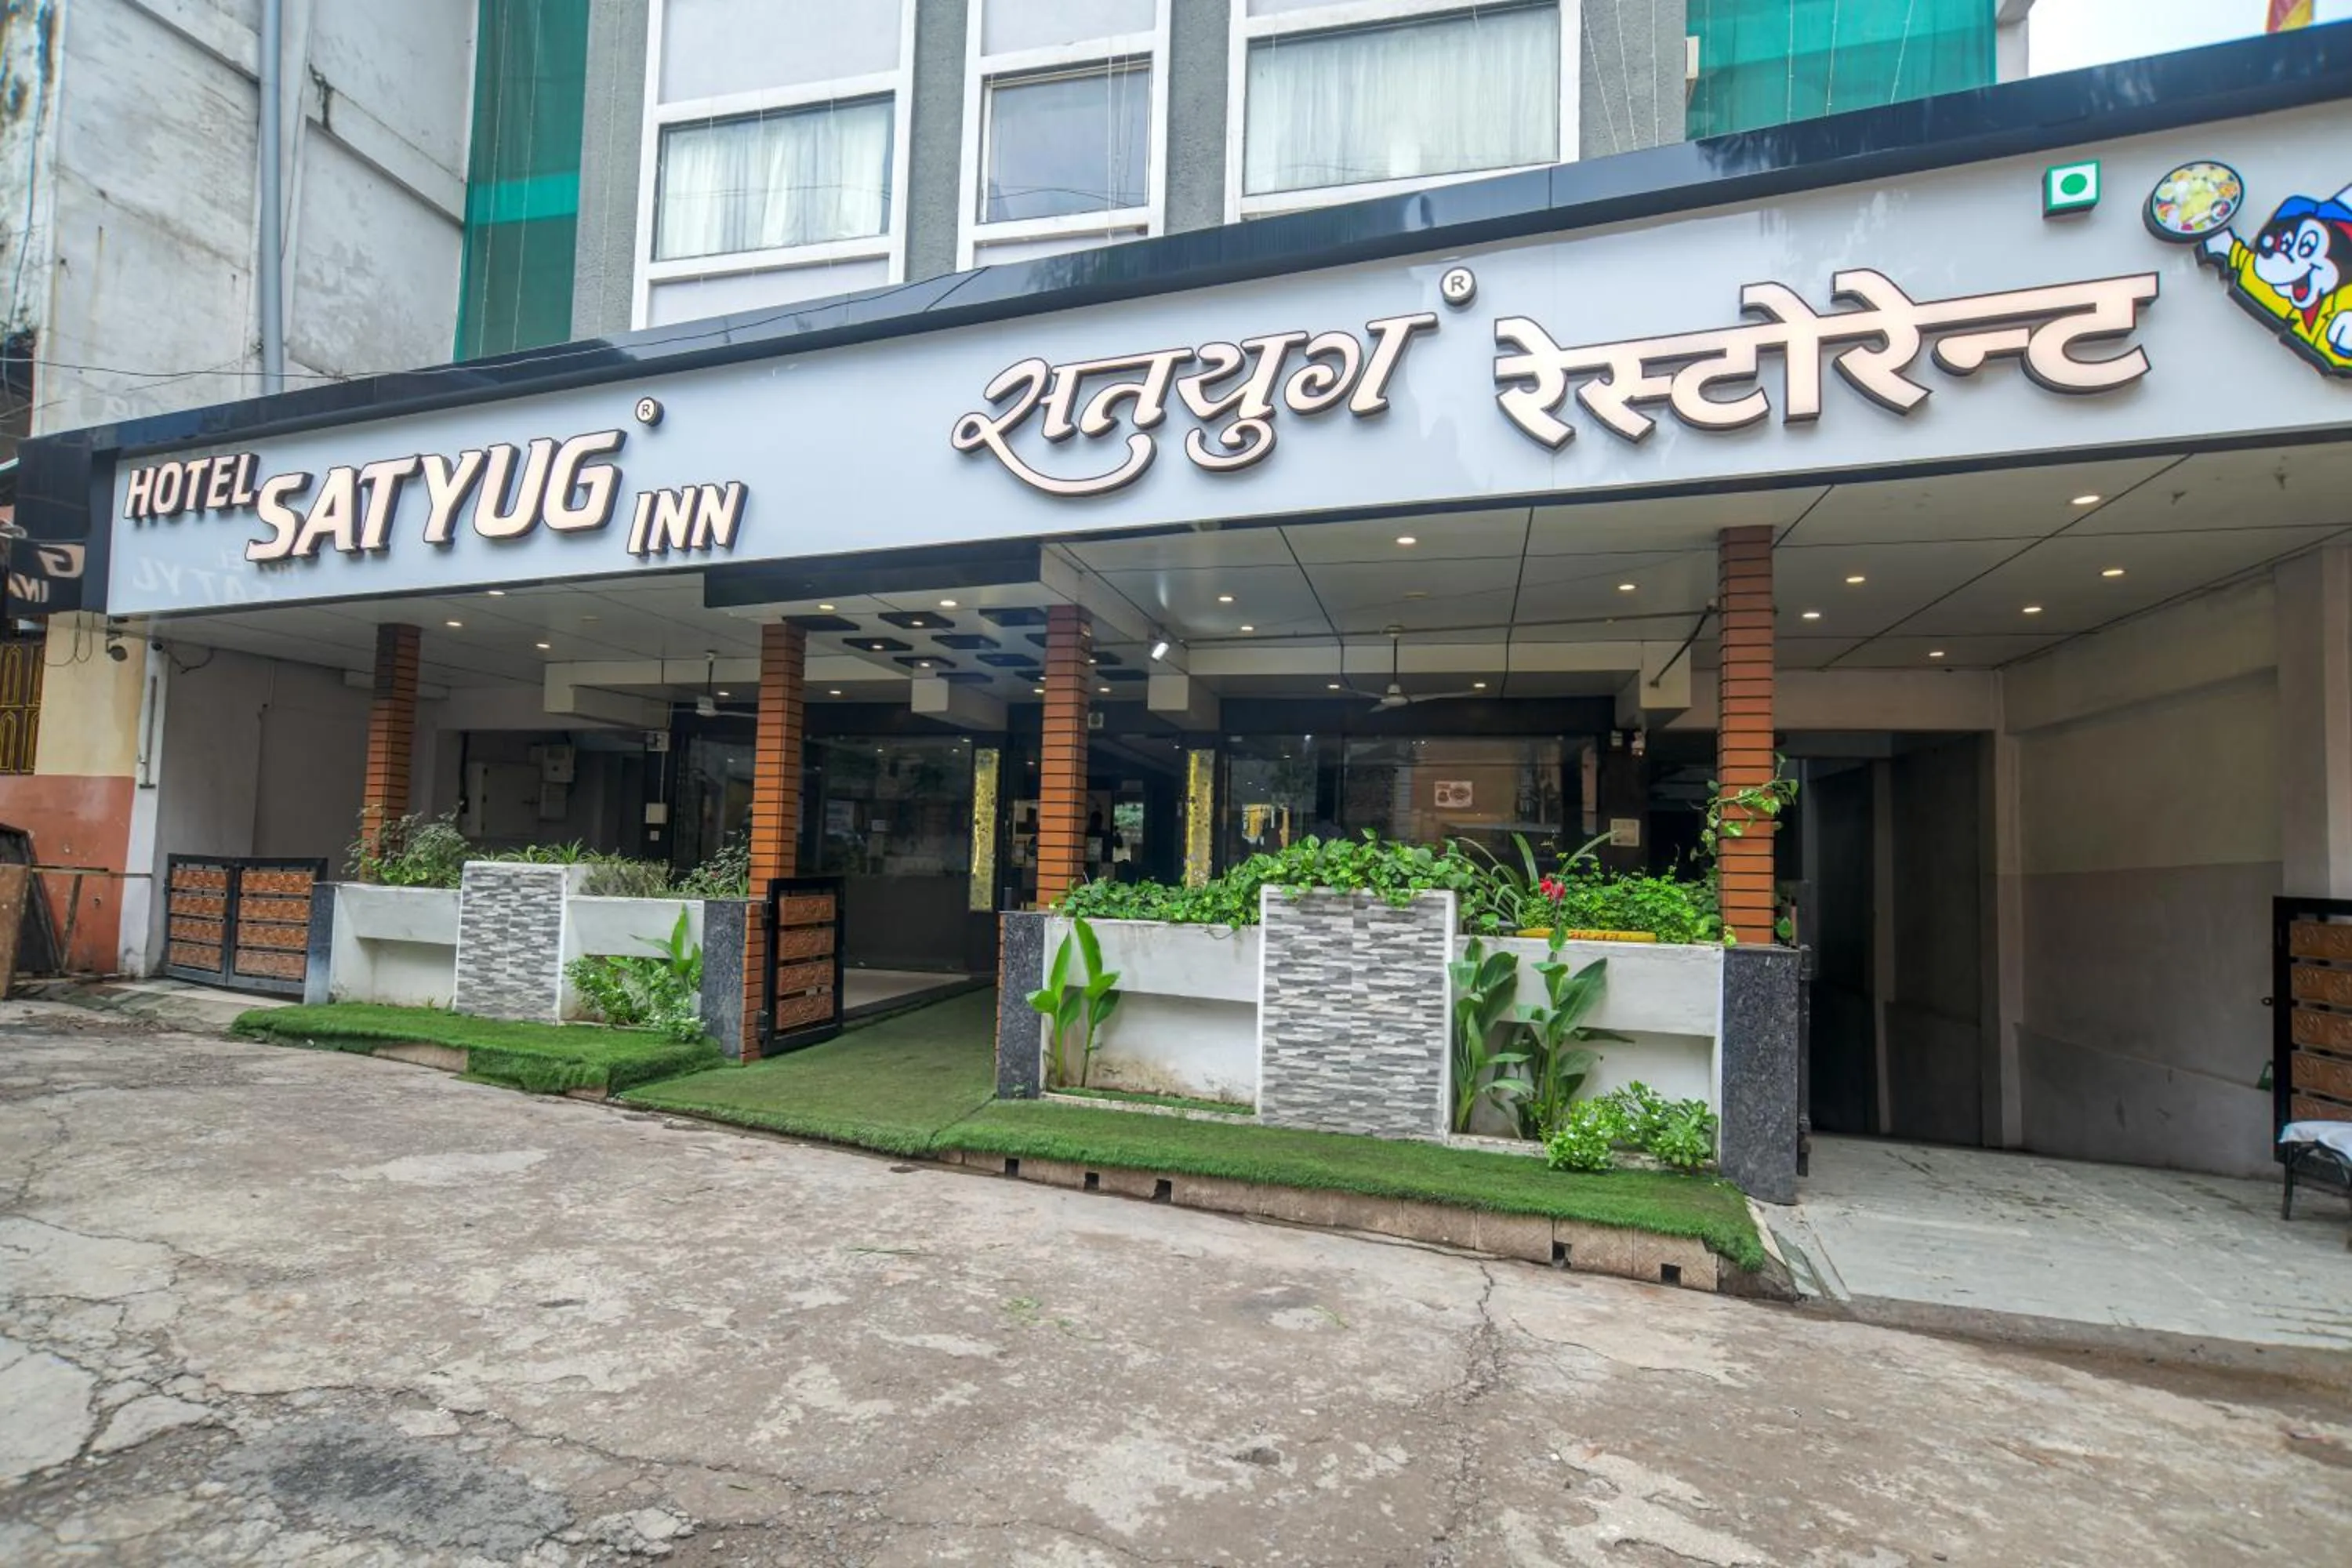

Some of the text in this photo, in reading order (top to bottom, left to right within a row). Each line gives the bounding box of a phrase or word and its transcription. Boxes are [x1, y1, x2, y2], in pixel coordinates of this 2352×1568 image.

[951, 312, 1439, 497] सतयुग
[1494, 267, 2160, 451] रेस्टोरेन्ट
[123, 452, 260, 519] HOTEL
[245, 429, 627, 563] SATYUG
[628, 481, 749, 555] INN
